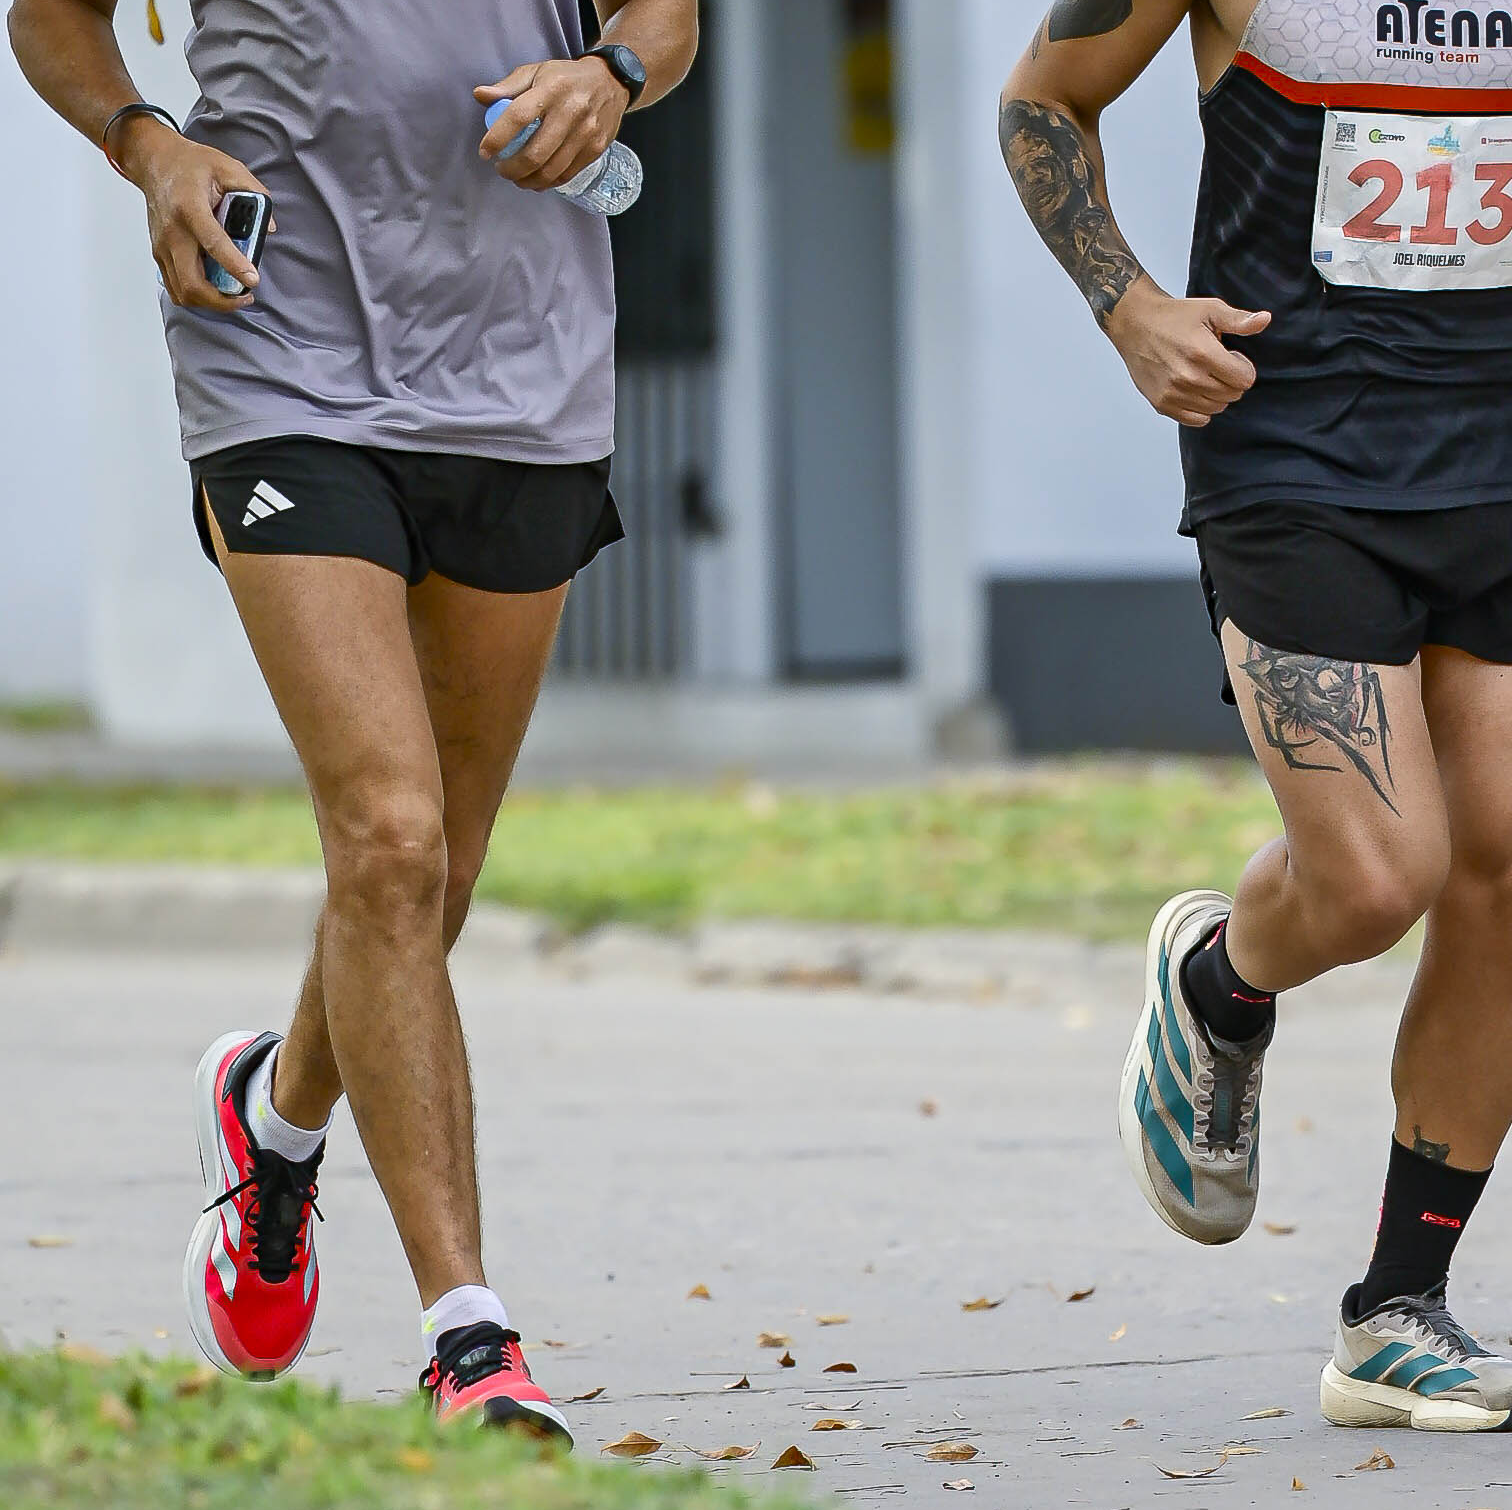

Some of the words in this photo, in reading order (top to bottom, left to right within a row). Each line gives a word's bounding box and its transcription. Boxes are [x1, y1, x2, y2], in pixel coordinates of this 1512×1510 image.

[1376, 48, 1434, 64] running
[1440, 50, 1480, 63] team
[1392, 252, 1415, 266] JOEL
[1416, 253, 1466, 267] RIQUELMES
